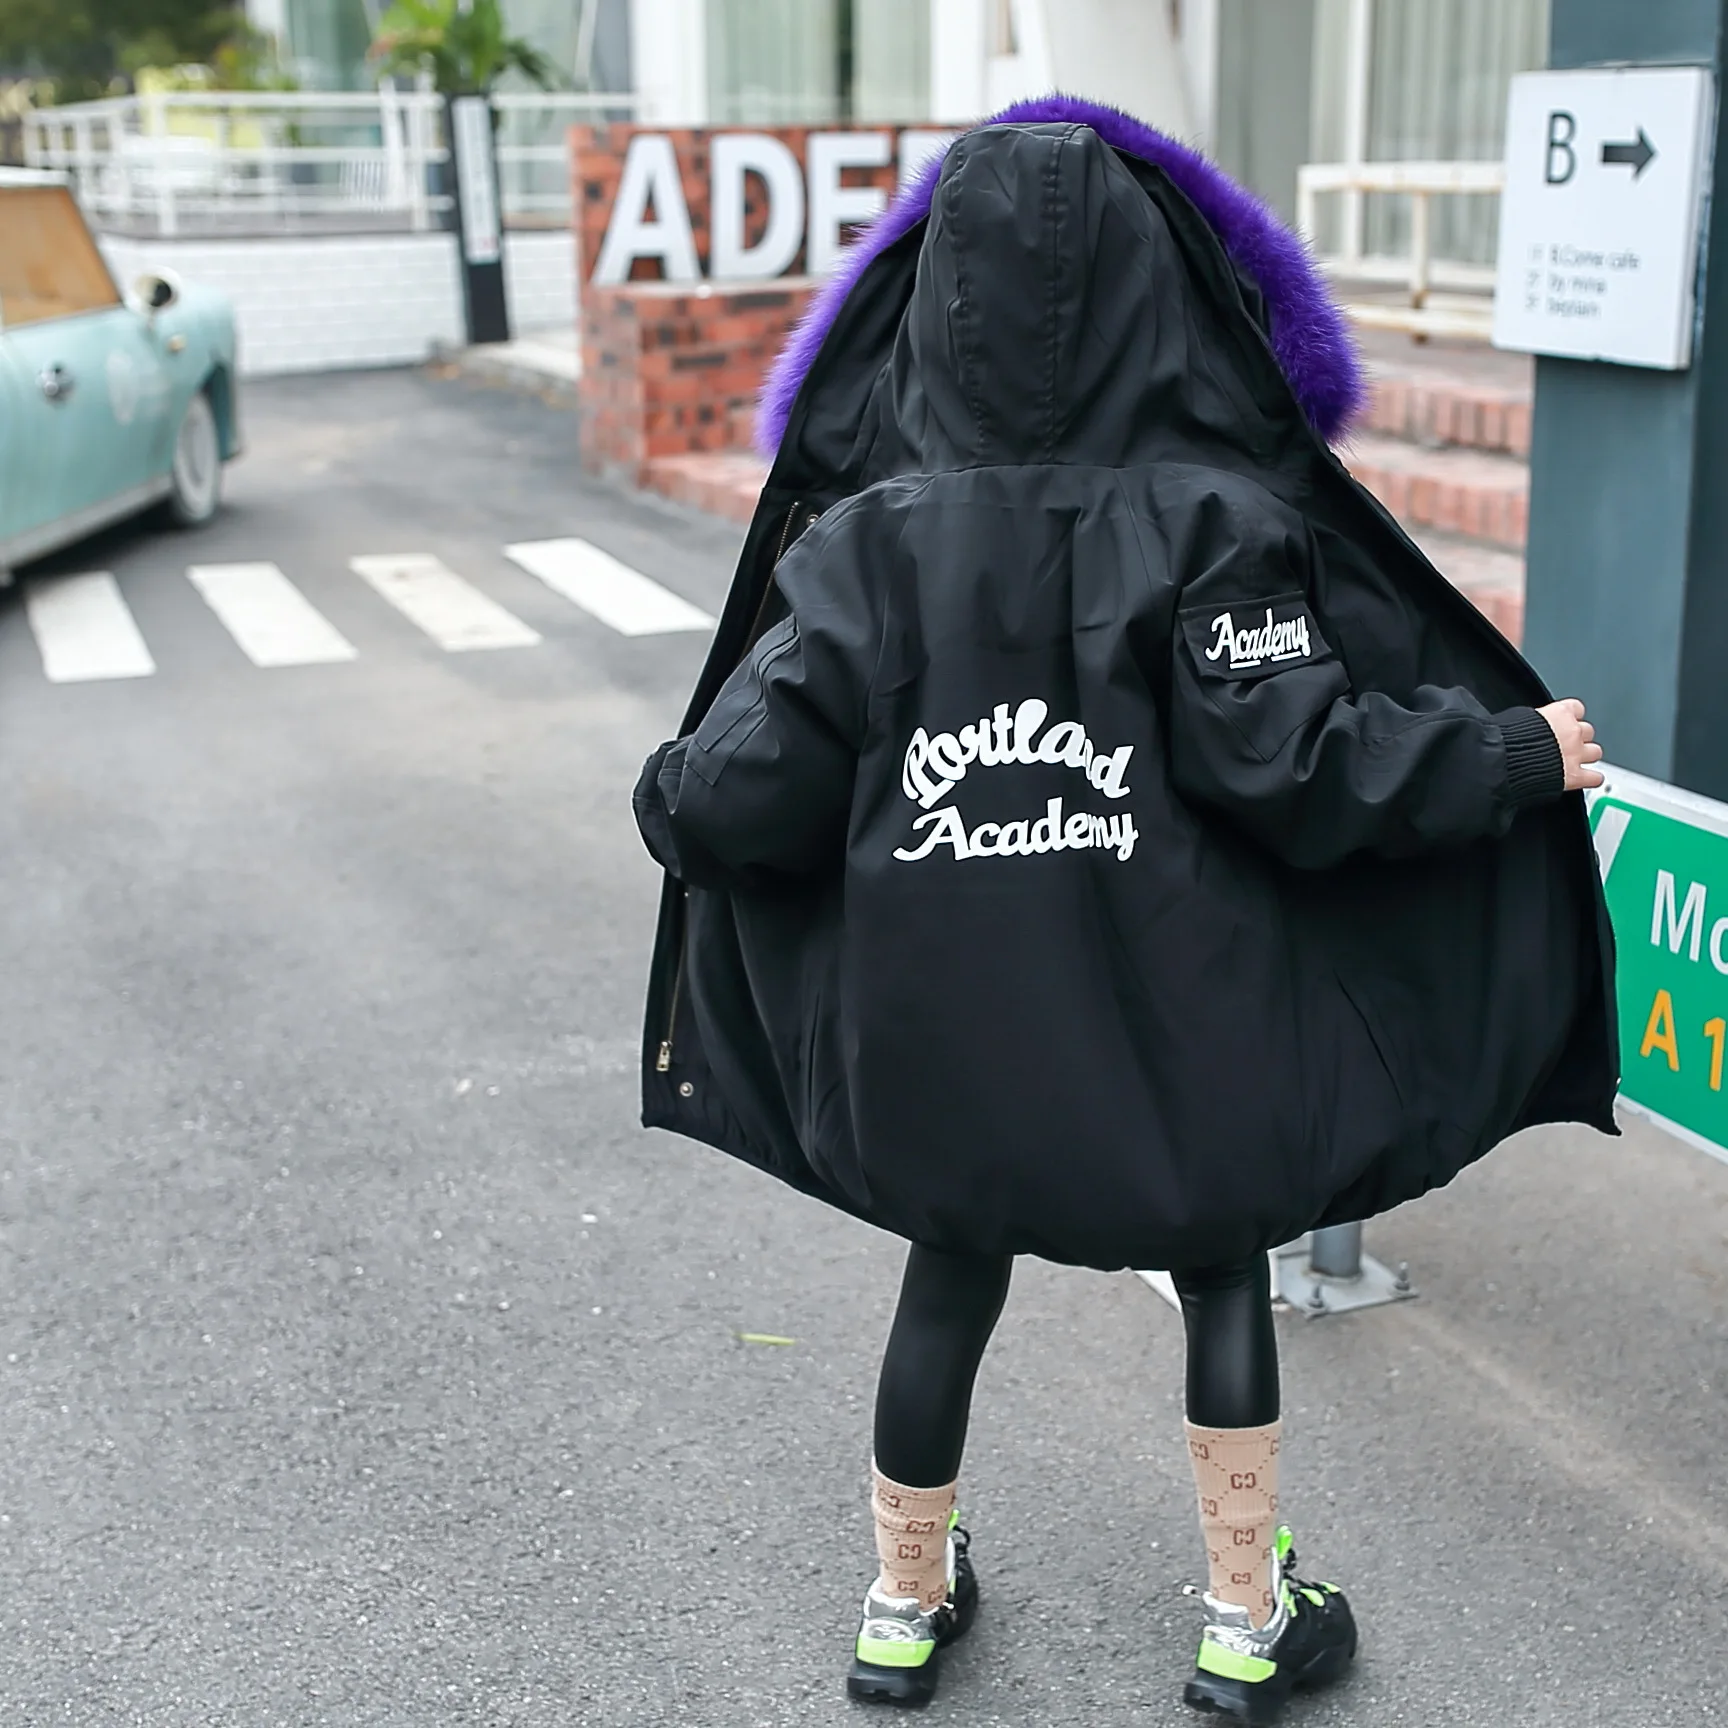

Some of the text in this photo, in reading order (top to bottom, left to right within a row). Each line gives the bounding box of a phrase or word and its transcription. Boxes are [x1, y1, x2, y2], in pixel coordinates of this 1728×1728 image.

[1544, 110, 1577, 184] B
[590, 132, 950, 284] ADE
[1205, 607, 1312, 663] Academy
[892, 797, 1139, 861] Academy
